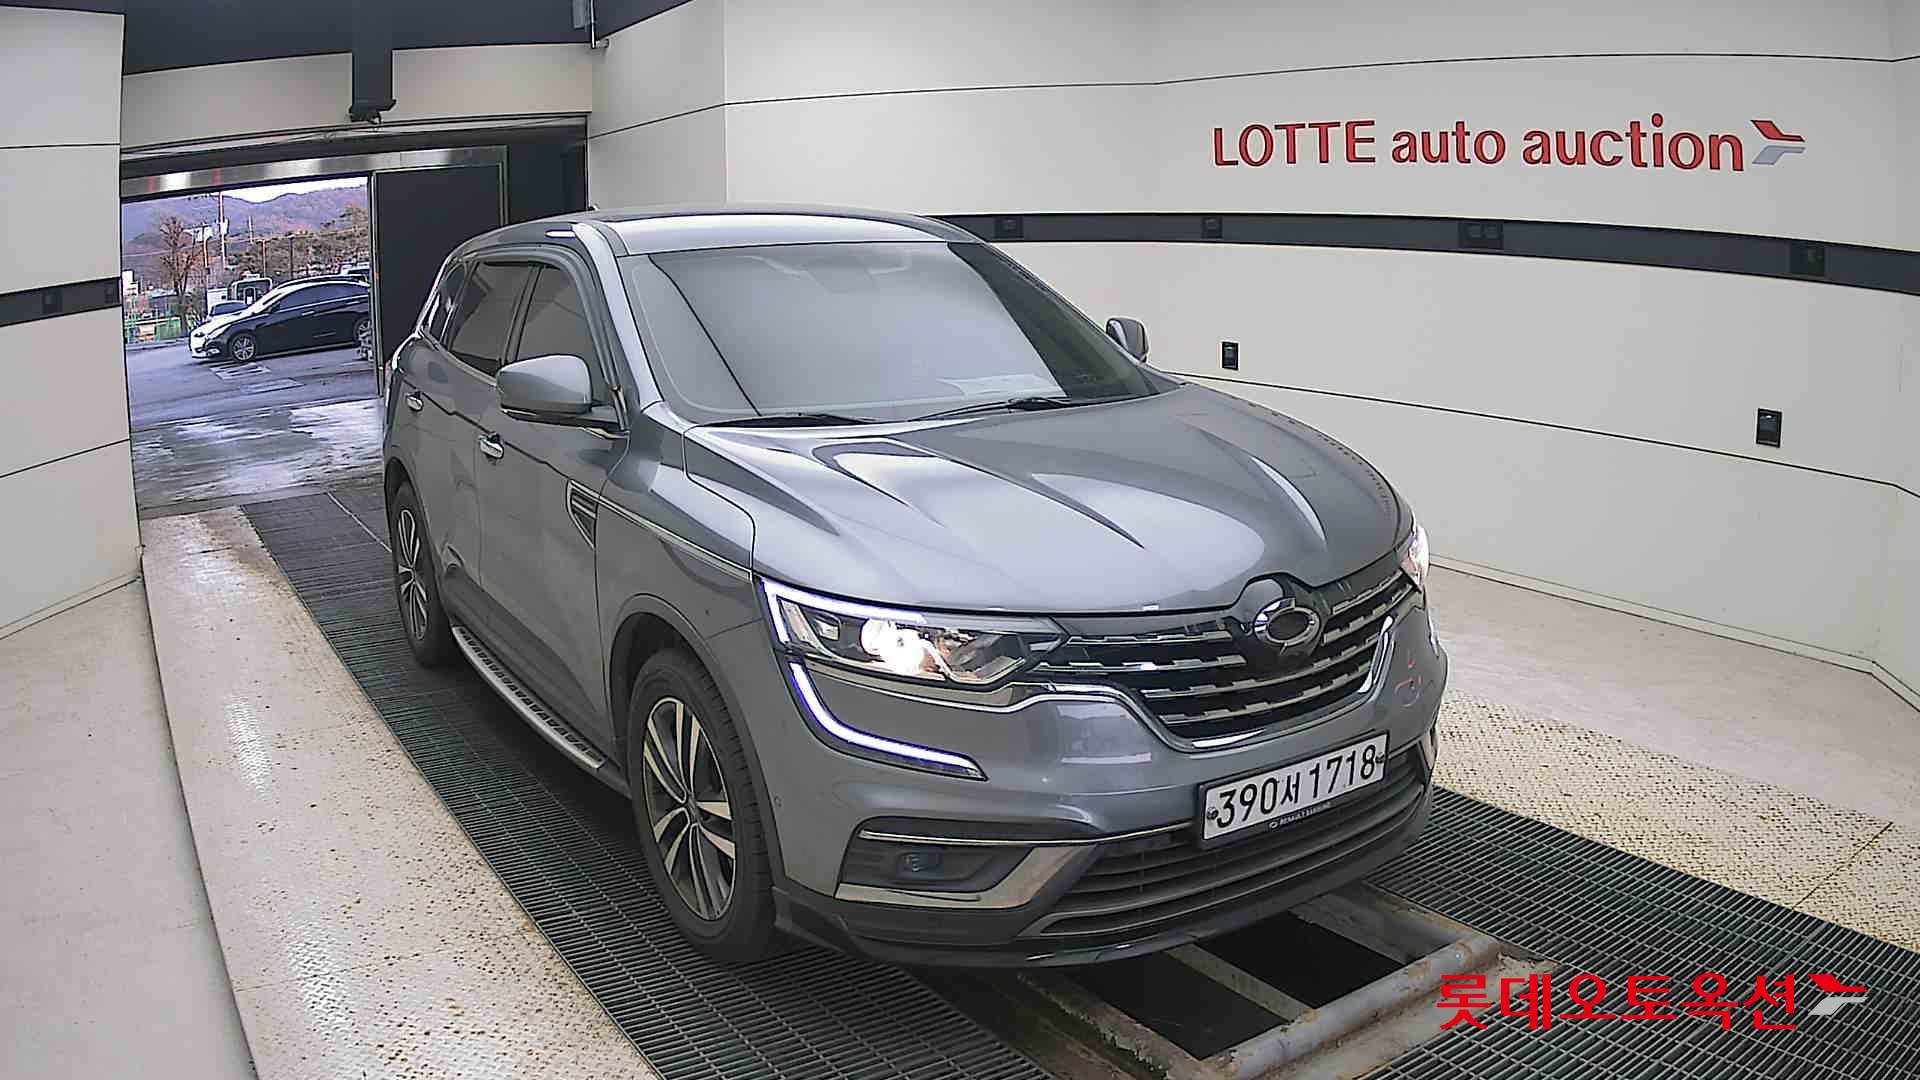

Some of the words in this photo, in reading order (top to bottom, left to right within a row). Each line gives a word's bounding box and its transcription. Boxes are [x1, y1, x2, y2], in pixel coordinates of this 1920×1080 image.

[1213, 120, 1376, 167] LOTTE
[1392, 121, 1507, 165] auto
[1523, 113, 1745, 172] auction
[1216, 772, 1301, 829] 390서
[1309, 744, 1377, 800] 1718
